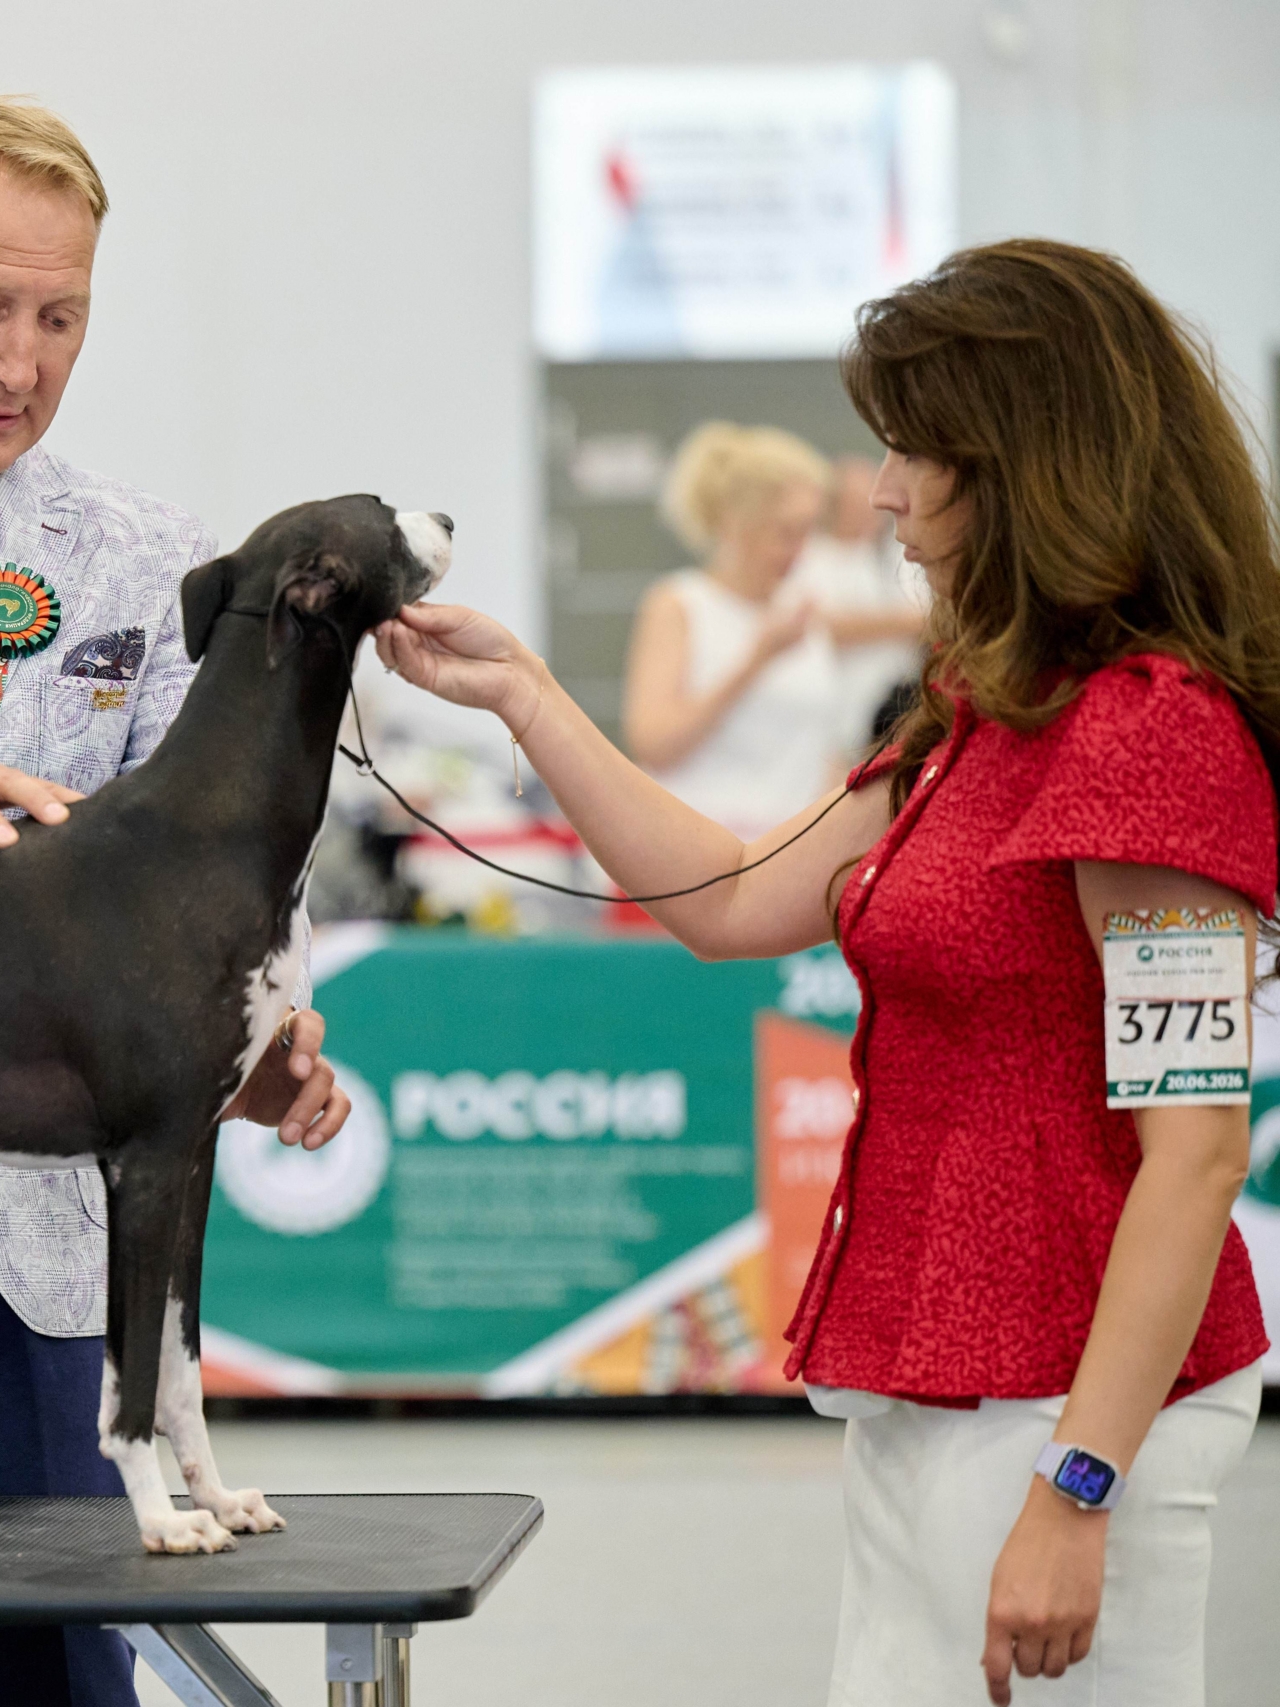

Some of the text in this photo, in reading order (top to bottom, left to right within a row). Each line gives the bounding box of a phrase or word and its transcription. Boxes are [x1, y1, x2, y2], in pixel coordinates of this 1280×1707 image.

[1158, 946, 1213, 958] РОССИЯ
[1117, 1000, 1236, 1044] 3775
[1165, 1073, 1245, 1091] 20.06.2026
[392, 1070, 687, 1140] РОССИЯ
